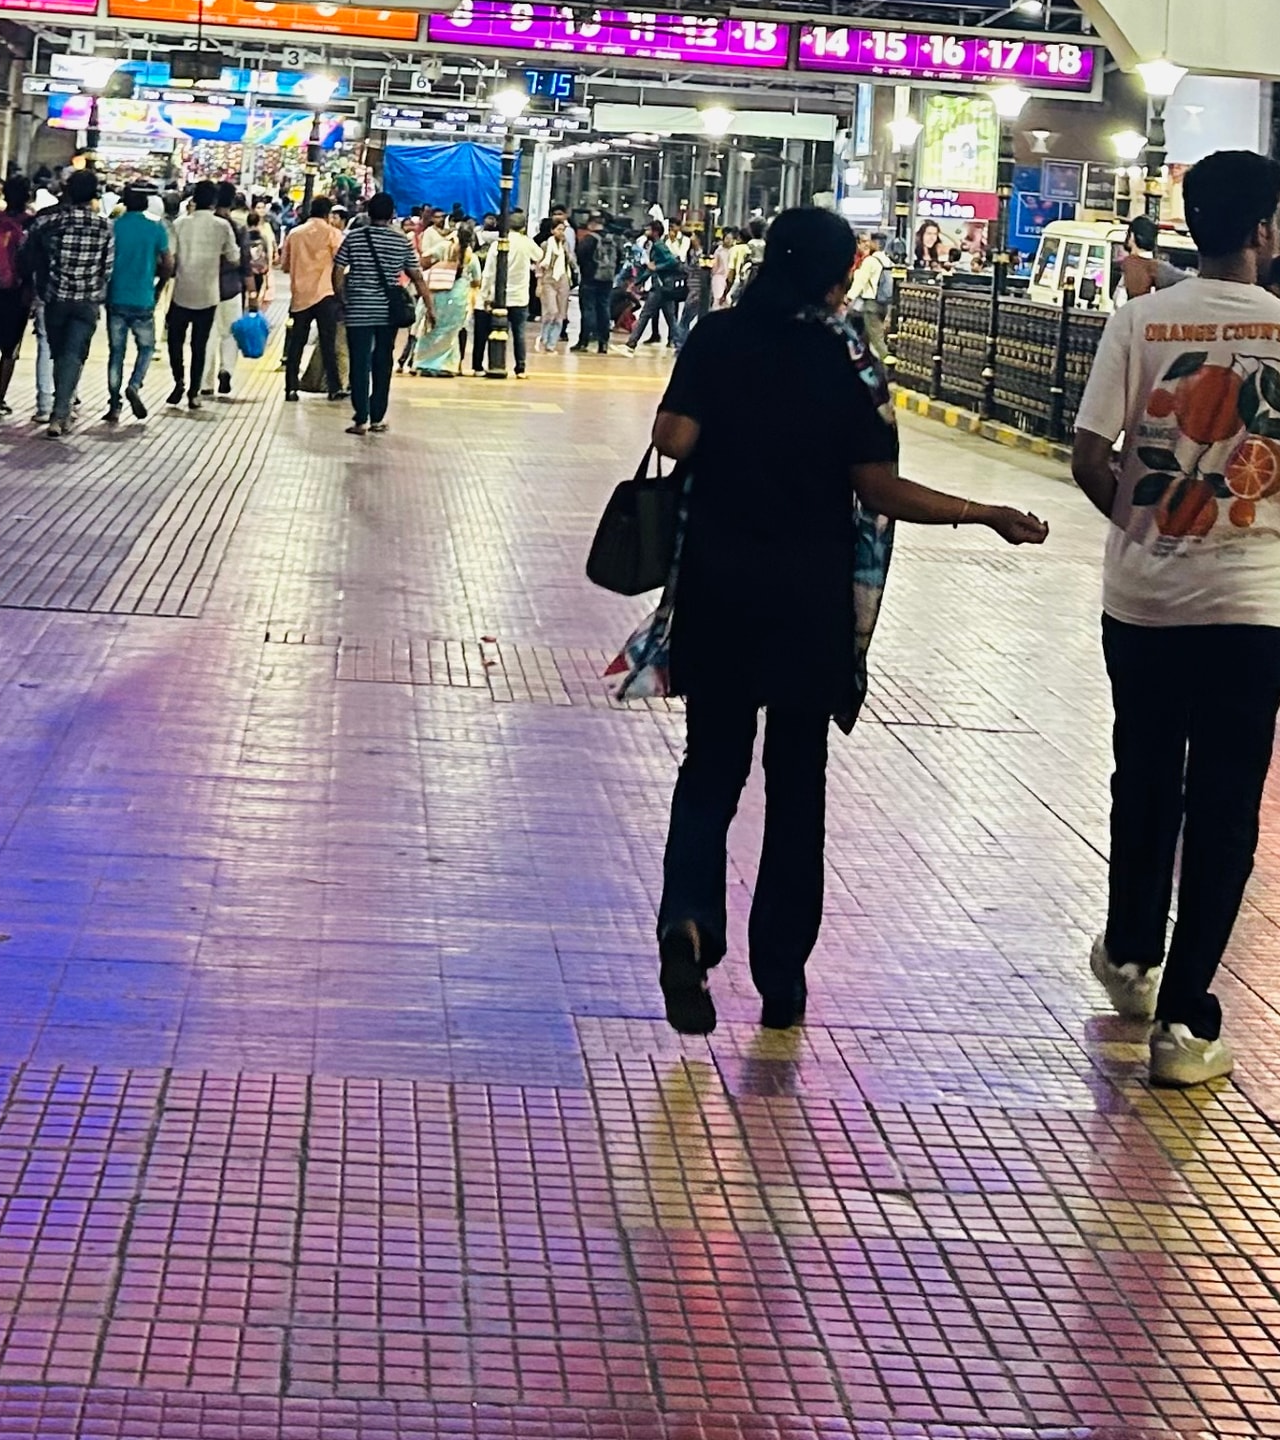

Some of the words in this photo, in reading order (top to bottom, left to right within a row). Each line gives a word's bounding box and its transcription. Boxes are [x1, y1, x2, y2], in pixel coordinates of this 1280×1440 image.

[509, 3, 533, 32] 9
[627, 12, 656, 41] 11
[742, 21, 777, 50] 13
[78, 35, 86, 50] 1
[811, 26, 850, 57] 14
[872, 31, 907, 61] 15
[928, 35, 966, 66] 16
[987, 39, 1024, 70] 17
[1045, 44, 1082, 75] 18
[288, 51, 299, 65] 3
[417, 77, 428, 89] 6
[526, 71, 572, 96] 7:15
[918, 200, 975, 218] Salon
[1145, 323, 1218, 342] ORANGE
